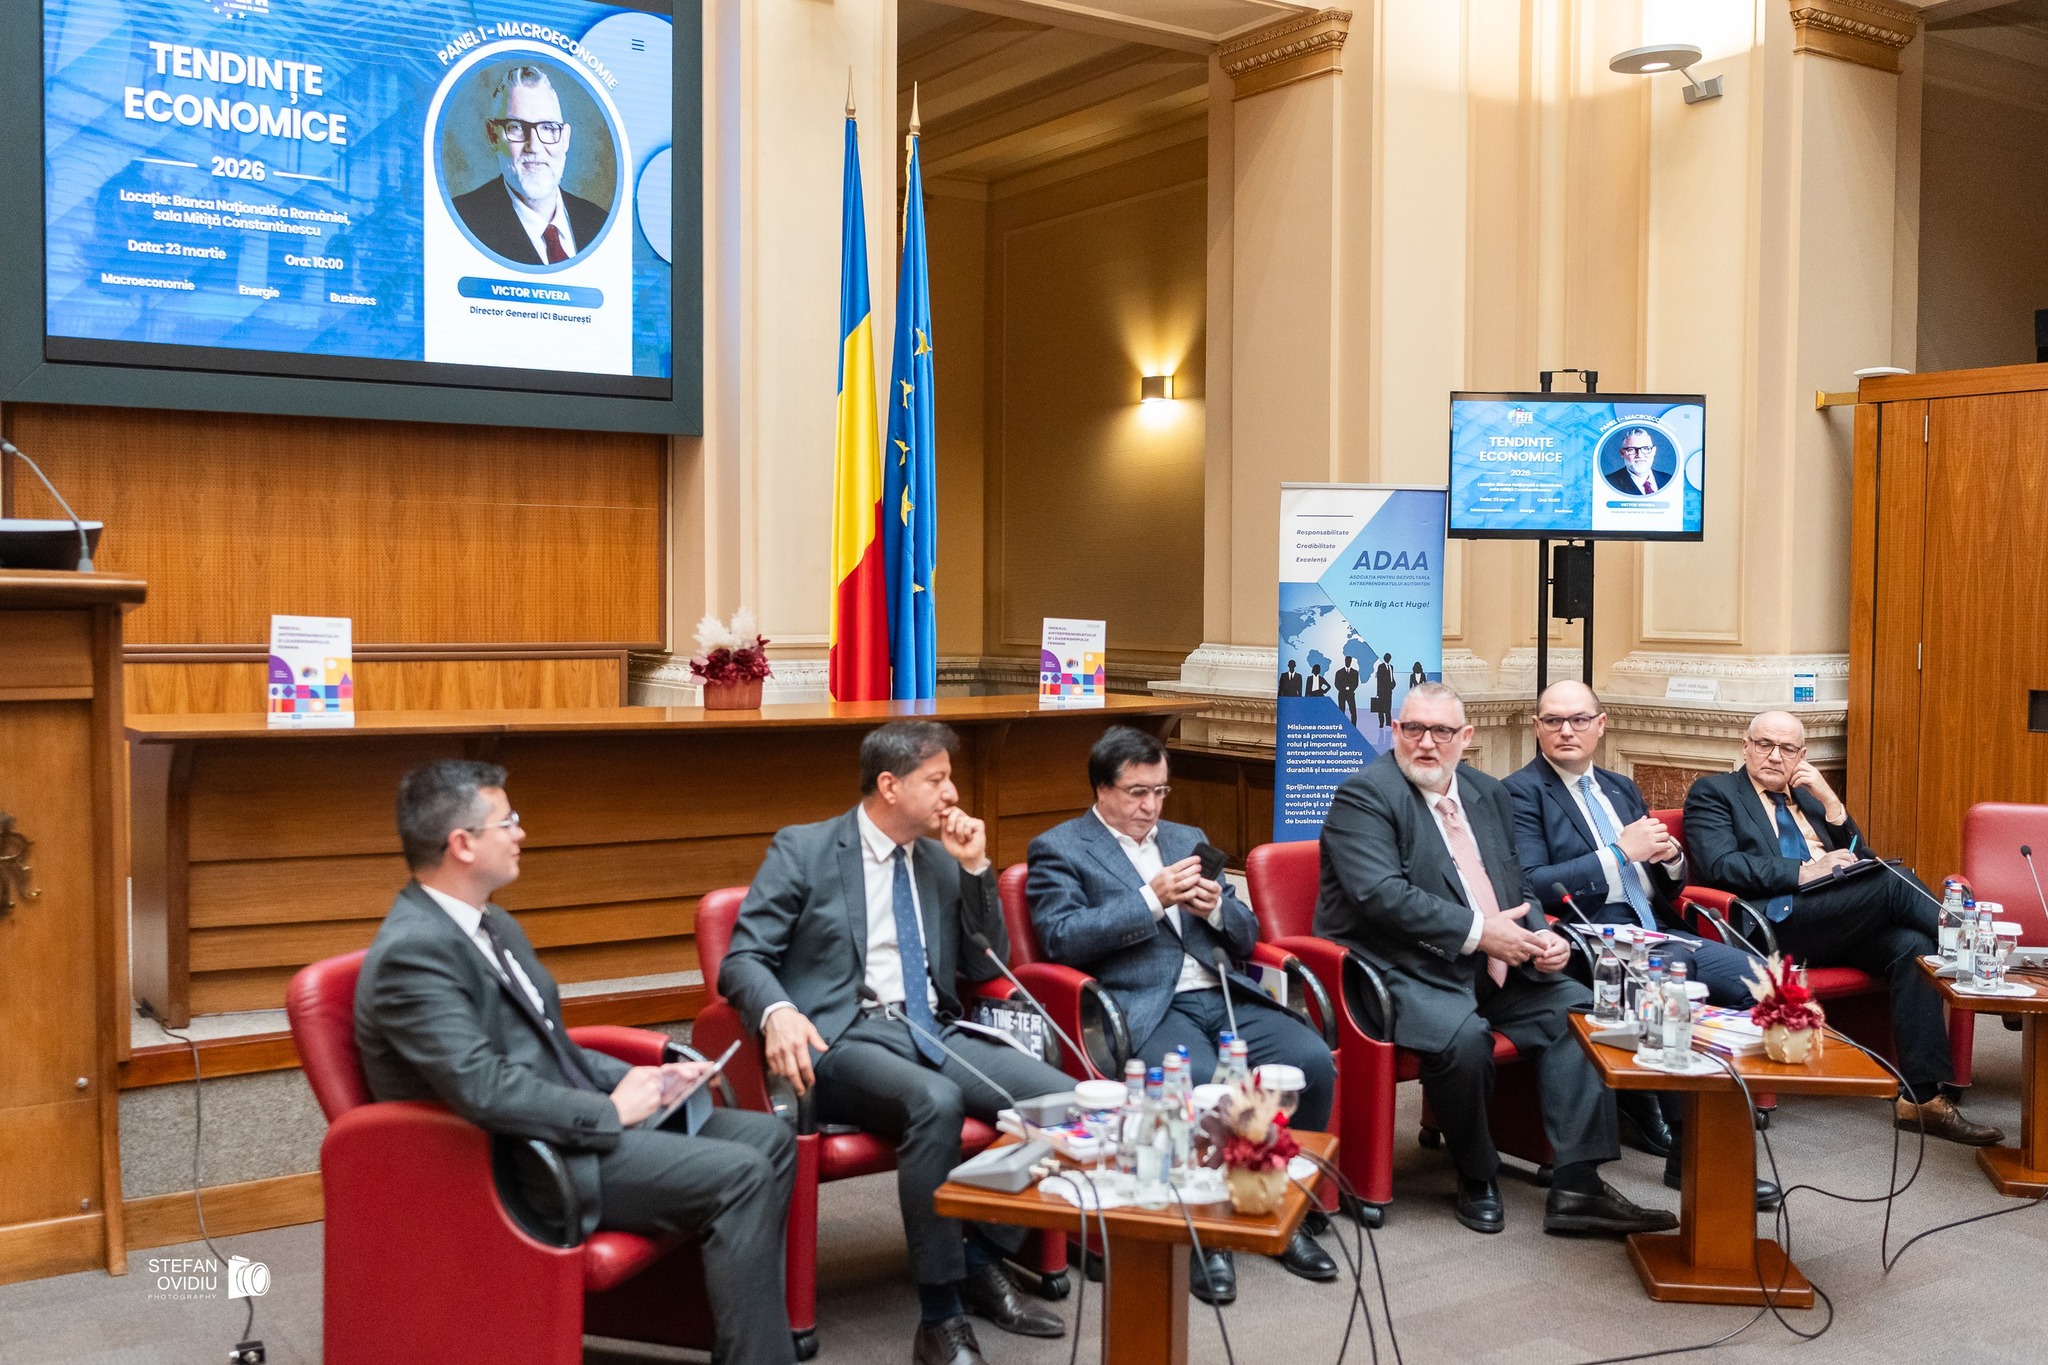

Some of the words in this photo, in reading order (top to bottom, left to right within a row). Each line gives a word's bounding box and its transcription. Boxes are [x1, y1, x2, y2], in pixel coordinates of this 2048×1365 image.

[437, 30, 480, 66] PANEL
[478, 27, 487, 41] 1
[497, 22, 619, 90] MACROECONOMIE
[149, 41, 323, 104] TENDINȚE
[124, 86, 347, 145] ECONOMICE
[211, 156, 266, 182] 2026
[120, 189, 172, 208] Locație:
[172, 195, 214, 210] Banca
[216, 200, 278, 216] Națională
[280, 208, 288, 218] a
[290, 208, 351, 226] României,
[154, 210, 182, 222] sala
[184, 212, 221, 230] Mitiță
[222, 216, 321, 236] Constantinescu
[128, 240, 164, 254] Data:
[165, 243, 181, 256] 23
[182, 247, 226, 260] martie
[285, 254, 312, 268] Ora:
[312, 256, 344, 270] 10:00
[102, 273, 195, 291] Macroeconomie
[240, 284, 280, 300] Energie
[330, 292, 376, 306] Business
[491, 284, 530, 298] VICTOR
[532, 288, 571, 301] VEVERA
[470, 306, 504, 316] Director
[506, 309, 538, 319] General
[540, 312, 551, 320] ICI
[552, 313, 592, 324] București
[1480, 451, 1562, 462] ECONOMICE
[1352, 551, 1428, 570] ADAA
[1374, 600, 1387, 609] Big
[1406, 601, 1430, 609] Huge!
